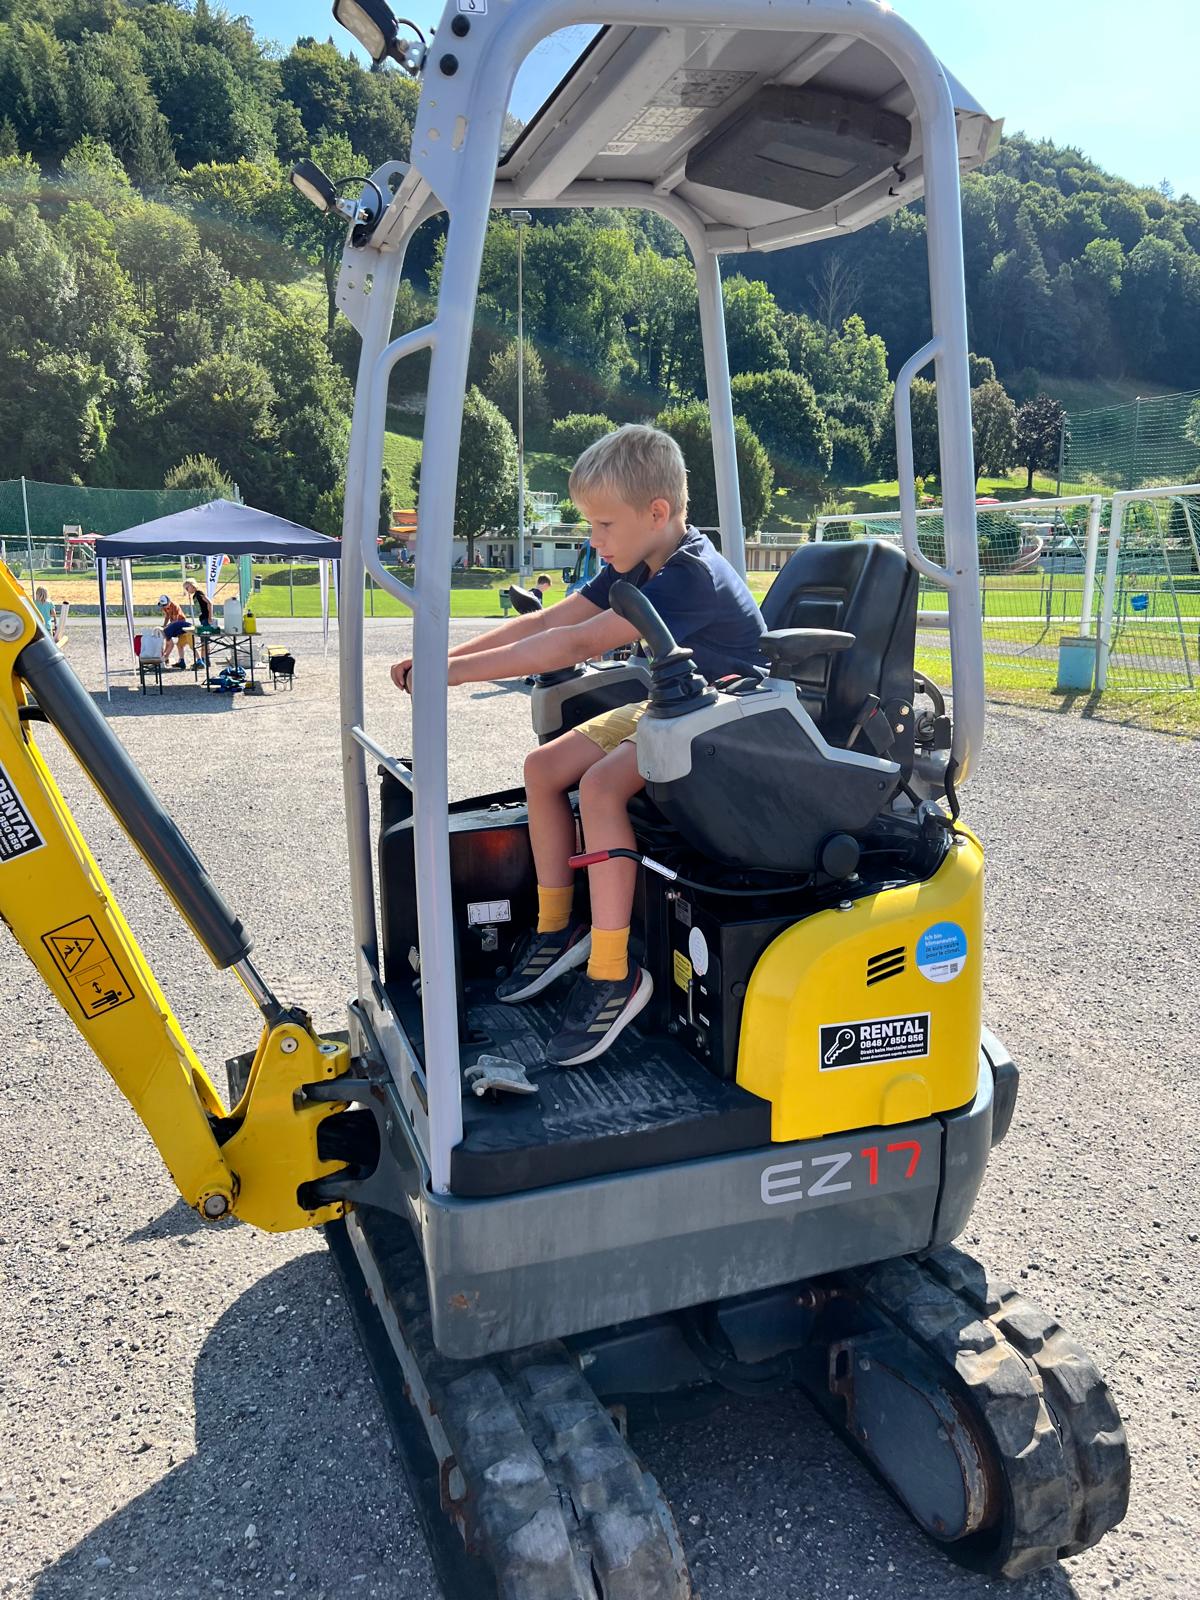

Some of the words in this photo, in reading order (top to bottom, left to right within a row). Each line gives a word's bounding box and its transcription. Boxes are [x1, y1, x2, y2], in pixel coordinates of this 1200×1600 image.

[209, 555, 218, 582] SCHMI
[860, 1019, 924, 1040] RENTAL
[860, 1039, 882, 1049] 0848
[890, 1036, 907, 1044] 850
